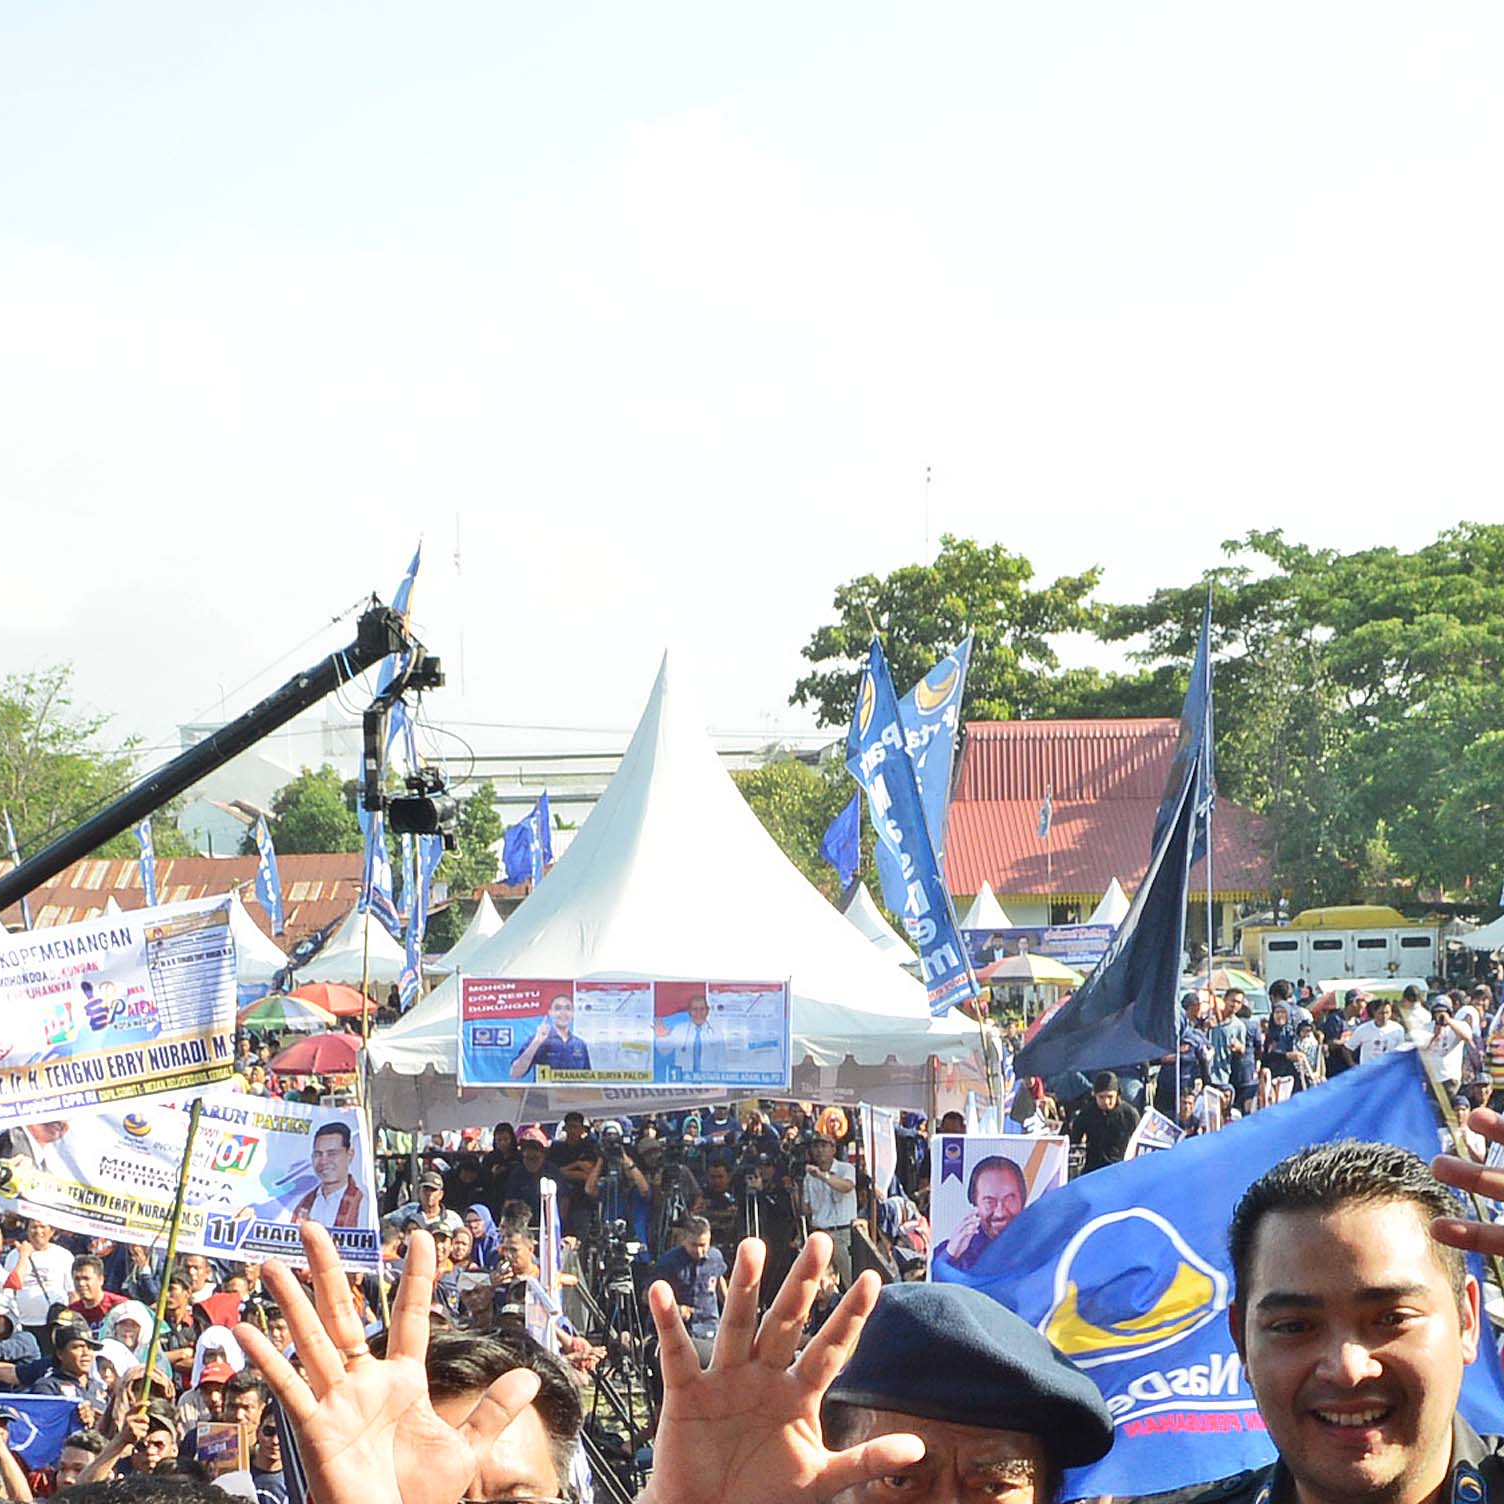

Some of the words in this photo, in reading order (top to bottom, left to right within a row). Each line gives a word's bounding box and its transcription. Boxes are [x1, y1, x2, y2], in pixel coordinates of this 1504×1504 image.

[497, 1030, 509, 1045] 5
[45, 1058, 104, 1088] TENGKU
[107, 1049, 145, 1078] ERRY
[540, 1070, 547, 1080] 1
[253, 1111, 312, 1135] PATEN
[216, 1137, 254, 1171] 01
[68, 1186, 108, 1208] TENGKU
[109, 1195, 135, 1214] ERRY
[209, 1216, 237, 1243] 11
